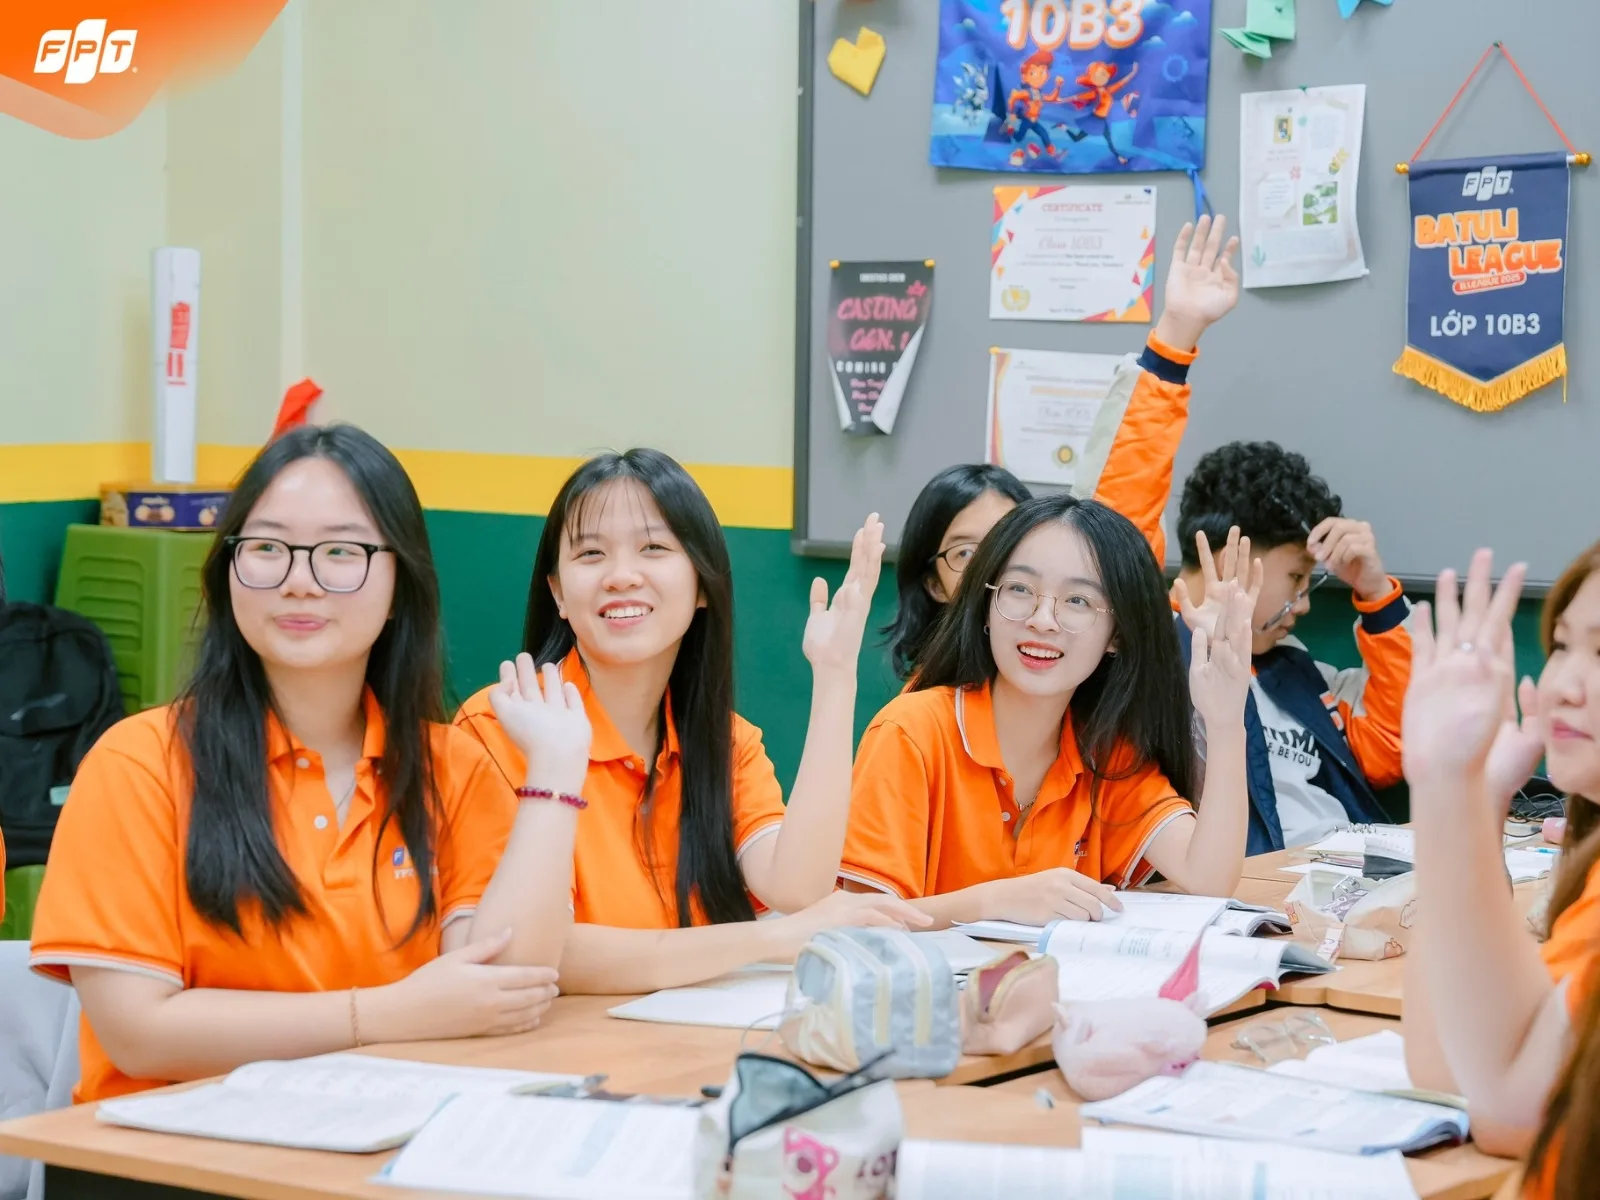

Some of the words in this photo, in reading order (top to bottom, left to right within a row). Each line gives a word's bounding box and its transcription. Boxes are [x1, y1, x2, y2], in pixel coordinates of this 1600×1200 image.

[1001, 0, 1144, 51] 10B3
[1041, 203, 1104, 213] CERTIFICATE
[1415, 208, 1519, 248] BATULI
[1449, 239, 1563, 279] LEAGUE
[837, 295, 918, 321] CASTING
[1430, 308, 1477, 337] LỚP
[1485, 313, 1541, 336] 10B3
[1278, 746, 1290, 758] BE
[1292, 751, 1312, 767] YOU
